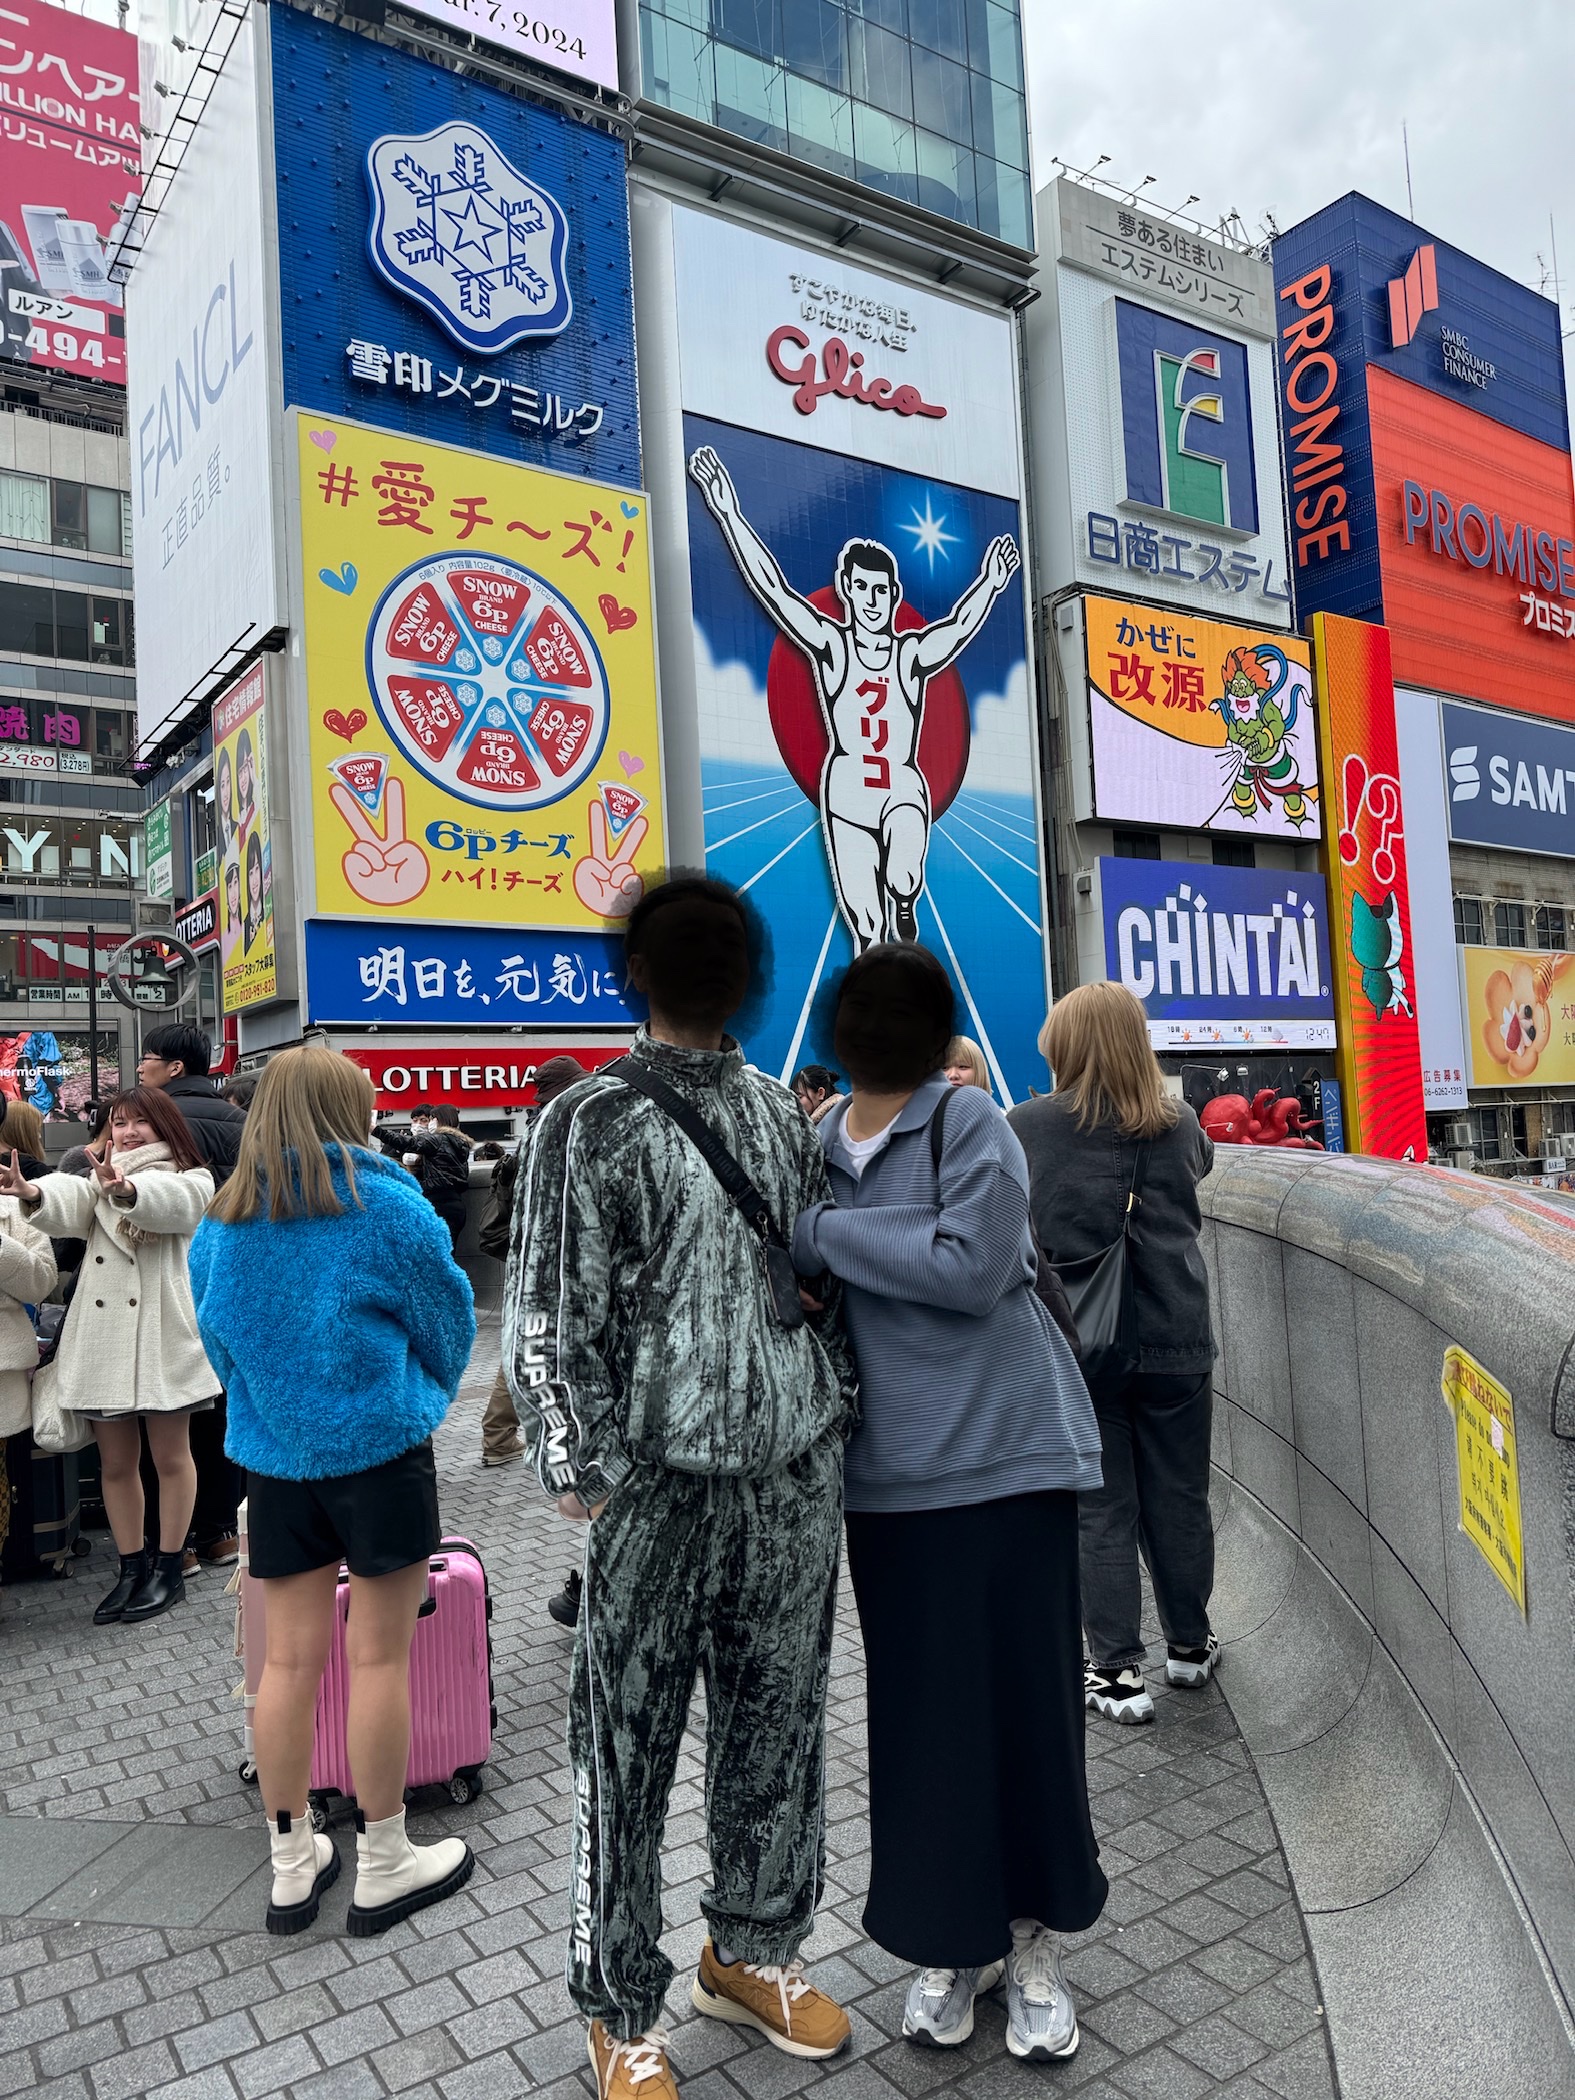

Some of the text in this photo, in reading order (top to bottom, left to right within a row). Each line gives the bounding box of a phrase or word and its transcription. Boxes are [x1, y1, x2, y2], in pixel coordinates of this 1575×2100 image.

[513, 11, 587, 60] 2024
[1117, 210, 1224, 272] 夢ある住まい
[1101, 242, 1244, 318] エステムシリーズ
[15, 295, 73, 320] ルアン
[789, 272, 917, 333] すこやかな毎日、
[800, 299, 908, 352] ゆたかな人生
[1441, 325, 1470, 350] SMBC
[766, 325, 947, 419] Glico
[1442, 341, 1497, 380] CONSUMER
[1444, 356, 1488, 390] FINANCE
[139, 259, 254, 519] FANCL
[345, 337, 604, 435] 雪印メグミルク
[1279, 263, 1350, 567] PROMISE
[162, 444, 231, 571] 正直品質。
[1087, 511, 1291, 602] 日商エステム
[1403, 479, 1575, 599] PROMISE
[463, 576, 518, 600] SNOW
[478, 594, 503, 604] BRAND
[394, 592, 431, 647] SNOW
[415, 616, 431, 640] BRAND
[474, 620, 508, 634] CHEESE
[1115, 617, 1196, 658] かぜに
[436, 630, 458, 662] CHEESE
[526, 644, 549, 680] CHEESE
[548, 621, 586, 676] SNOW
[551, 640, 566, 666] BRAND
[1107, 651, 1206, 712] 改源
[394, 688, 438, 745] SNOW
[438, 684, 461, 721] CHEESE
[530, 700, 550, 731] CHEESE
[480, 730, 514, 743] CHEESE
[555, 714, 587, 768] SNOW
[856, 676, 891, 790] グリコ
[345, 761, 375, 775] SNOW
[470, 766, 526, 787] SNOW
[610, 790, 636, 806] SNOW
[1117, 885, 1320, 999] CHINTAI
[31, 989, 61, 1000] 営業時間
[0, 1066, 70, 1077] ermoFlask
[1423, 1069, 1462, 1083] 広告募集
[1424, 1086, 1462, 1097] 06-6262-1313
[523, 1311, 576, 1487] SUPREME
[575, 1768, 592, 1967] SUPREME
